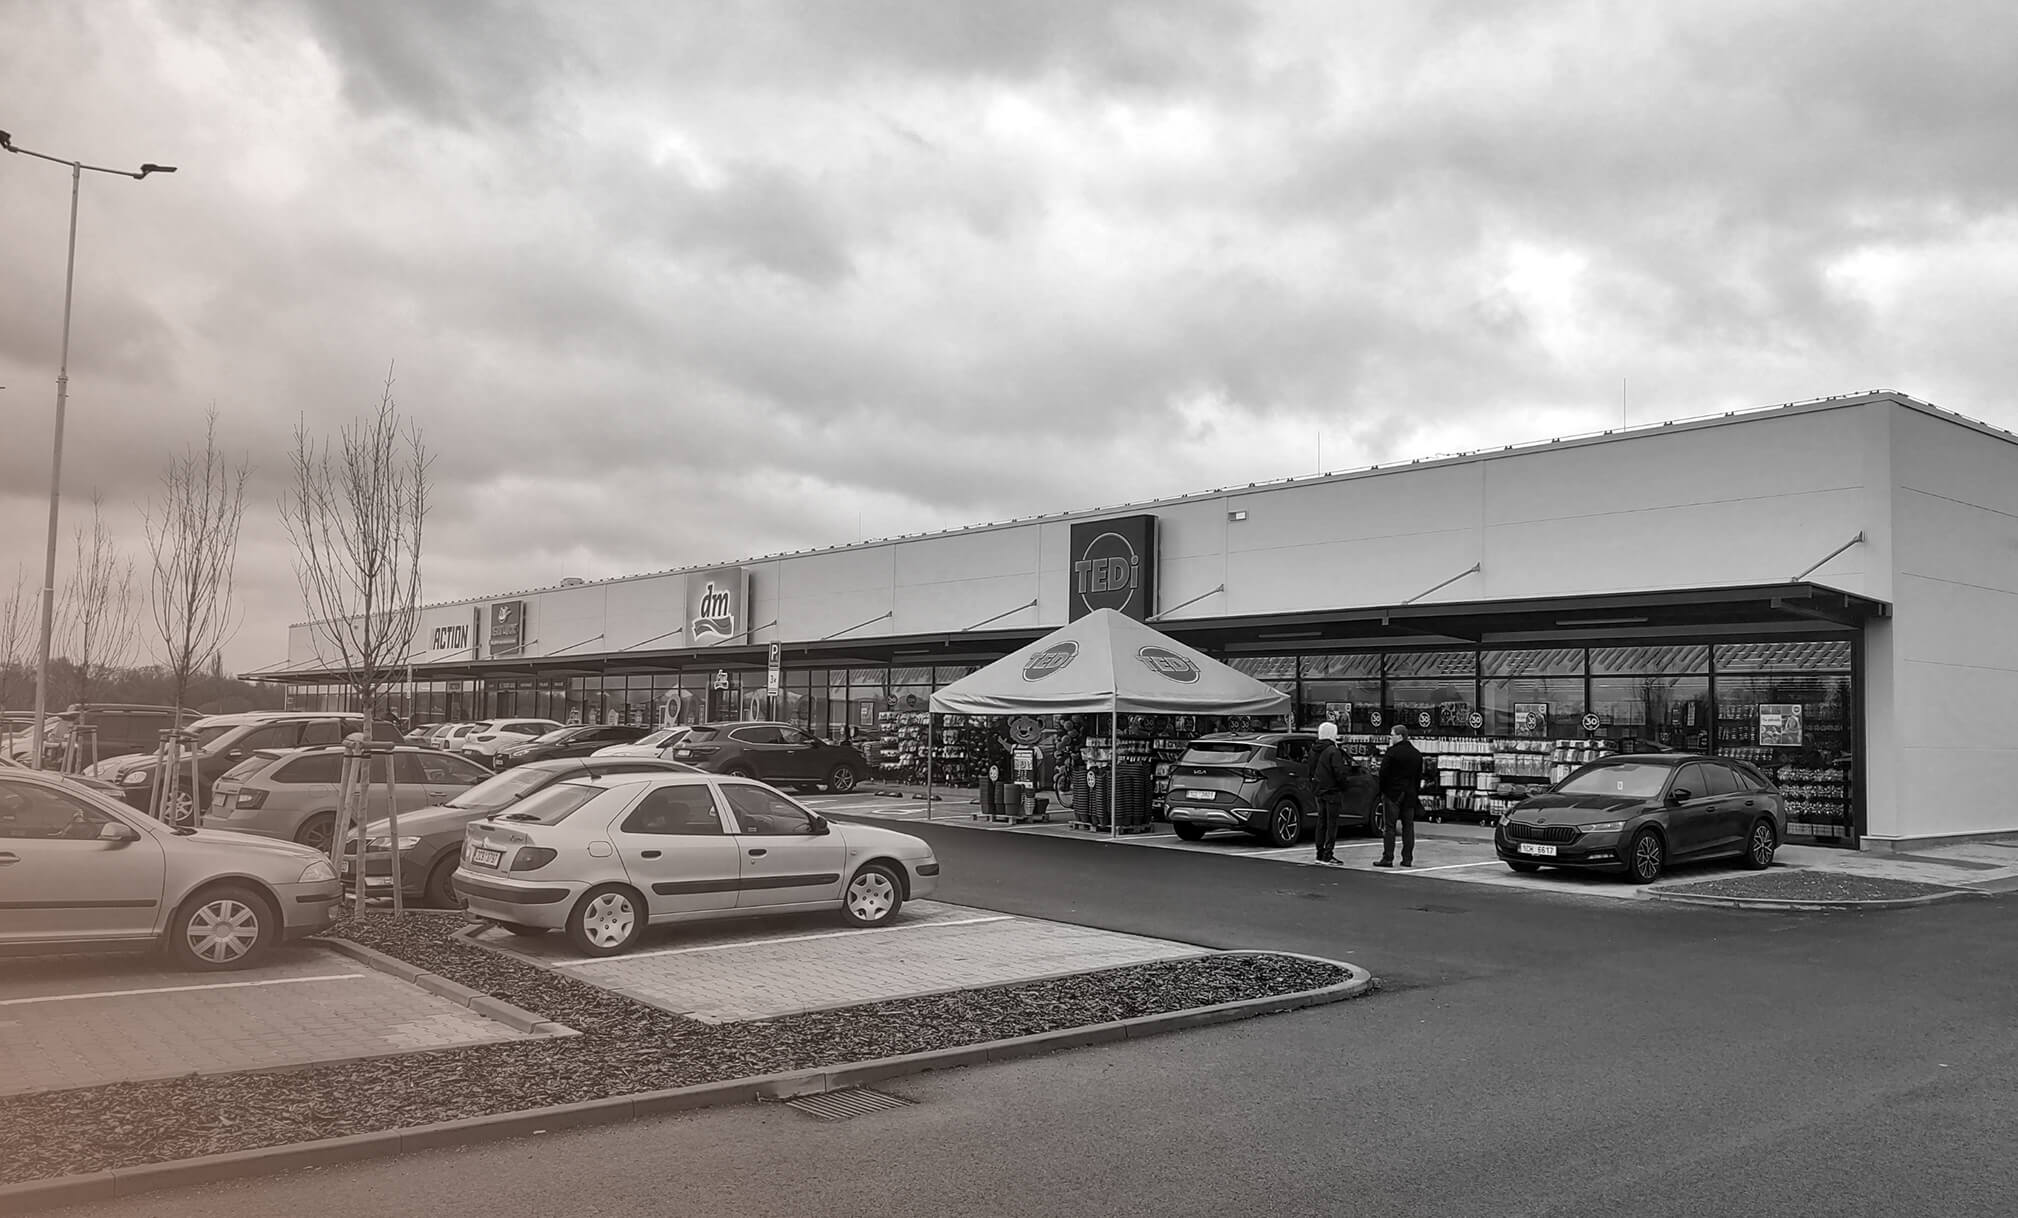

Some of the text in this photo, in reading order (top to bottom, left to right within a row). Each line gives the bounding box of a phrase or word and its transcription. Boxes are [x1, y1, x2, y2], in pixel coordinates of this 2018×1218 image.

[1075, 555, 1139, 593] TEDi
[701, 583, 729, 618] dm
[433, 624, 469, 650] ACTION
[771, 644, 778, 661] P
[1024, 652, 1076, 670] TEDi
[1136, 655, 1201, 672] TEDi
[1471, 716, 1481, 724] 30
[1584, 716, 1598, 726] 30
